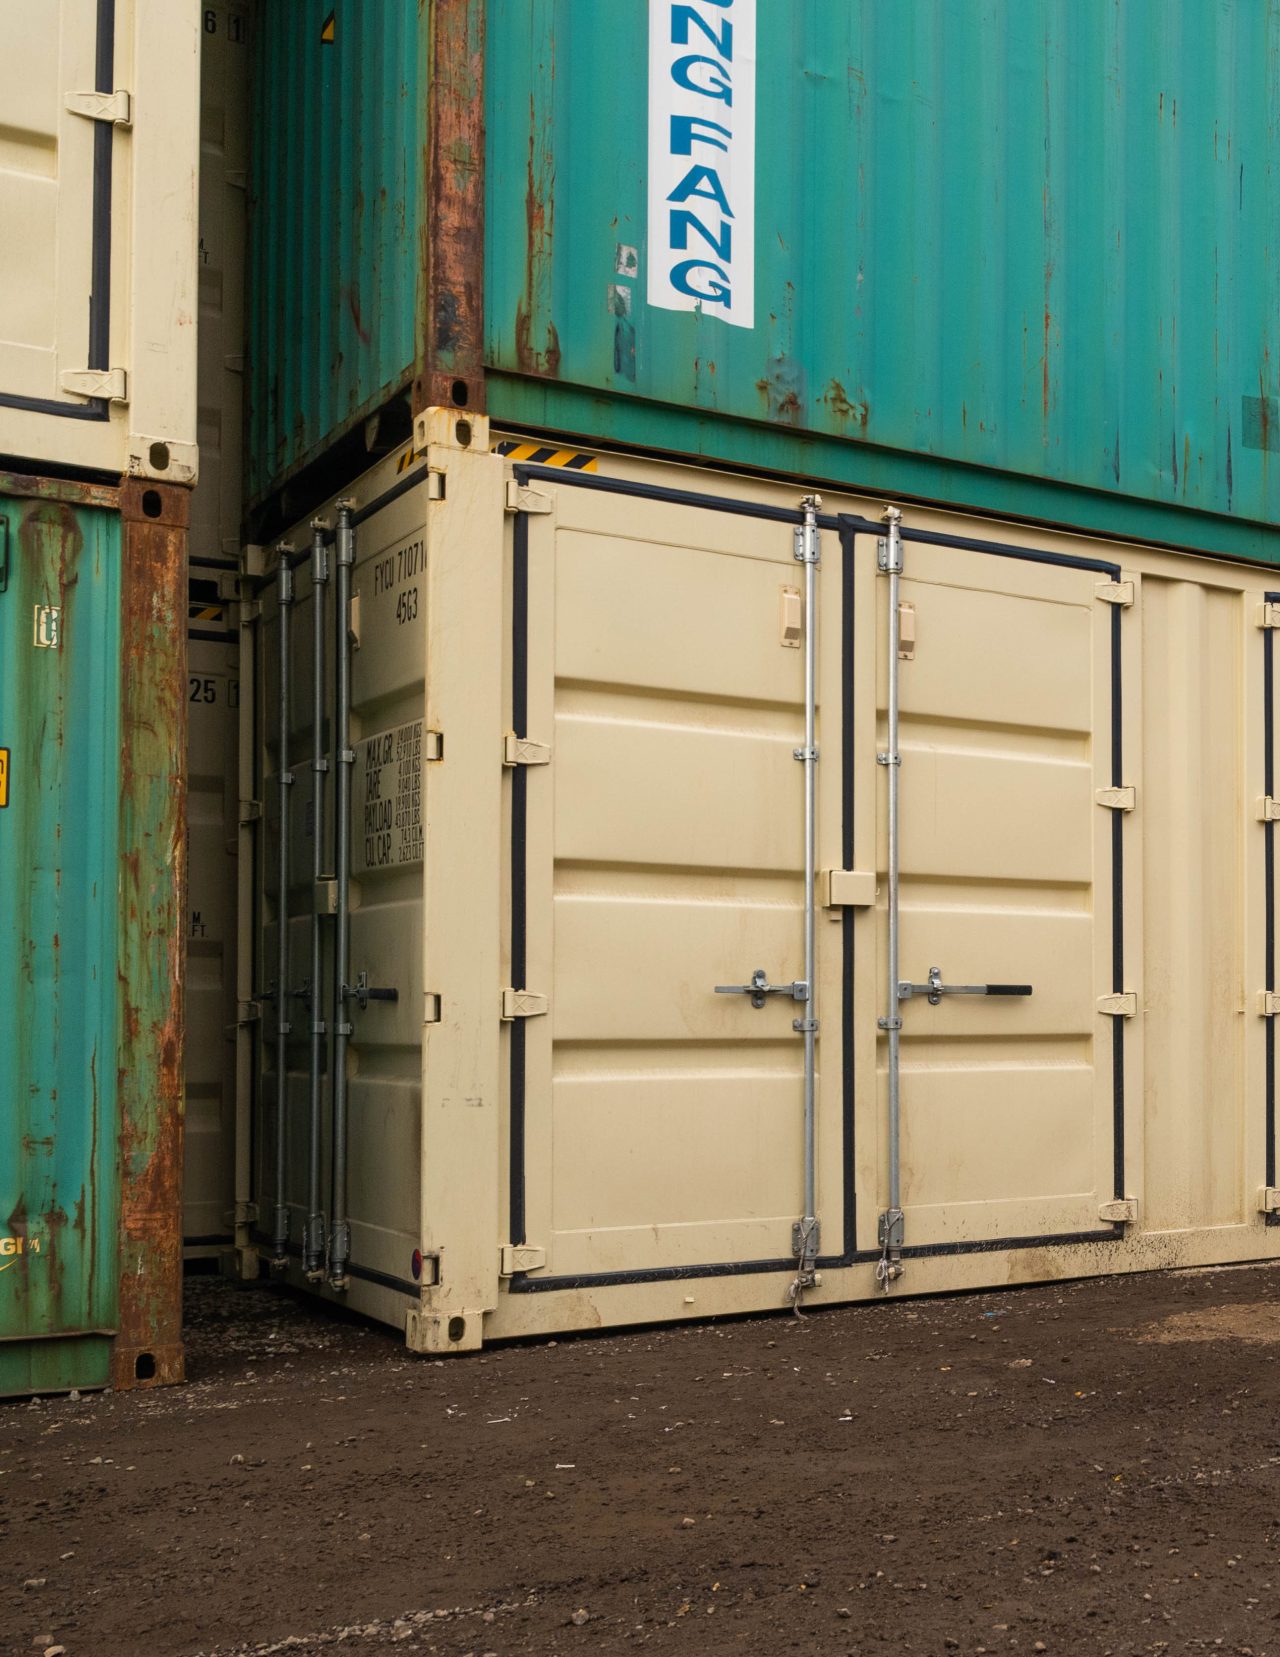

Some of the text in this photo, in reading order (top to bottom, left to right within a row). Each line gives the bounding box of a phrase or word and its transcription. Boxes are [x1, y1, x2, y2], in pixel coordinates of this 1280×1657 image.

[665, 0, 736, 310] NG FANG
[396, 587, 418, 626] 45G3
[364, 799, 393, 836] PAYLOAD
